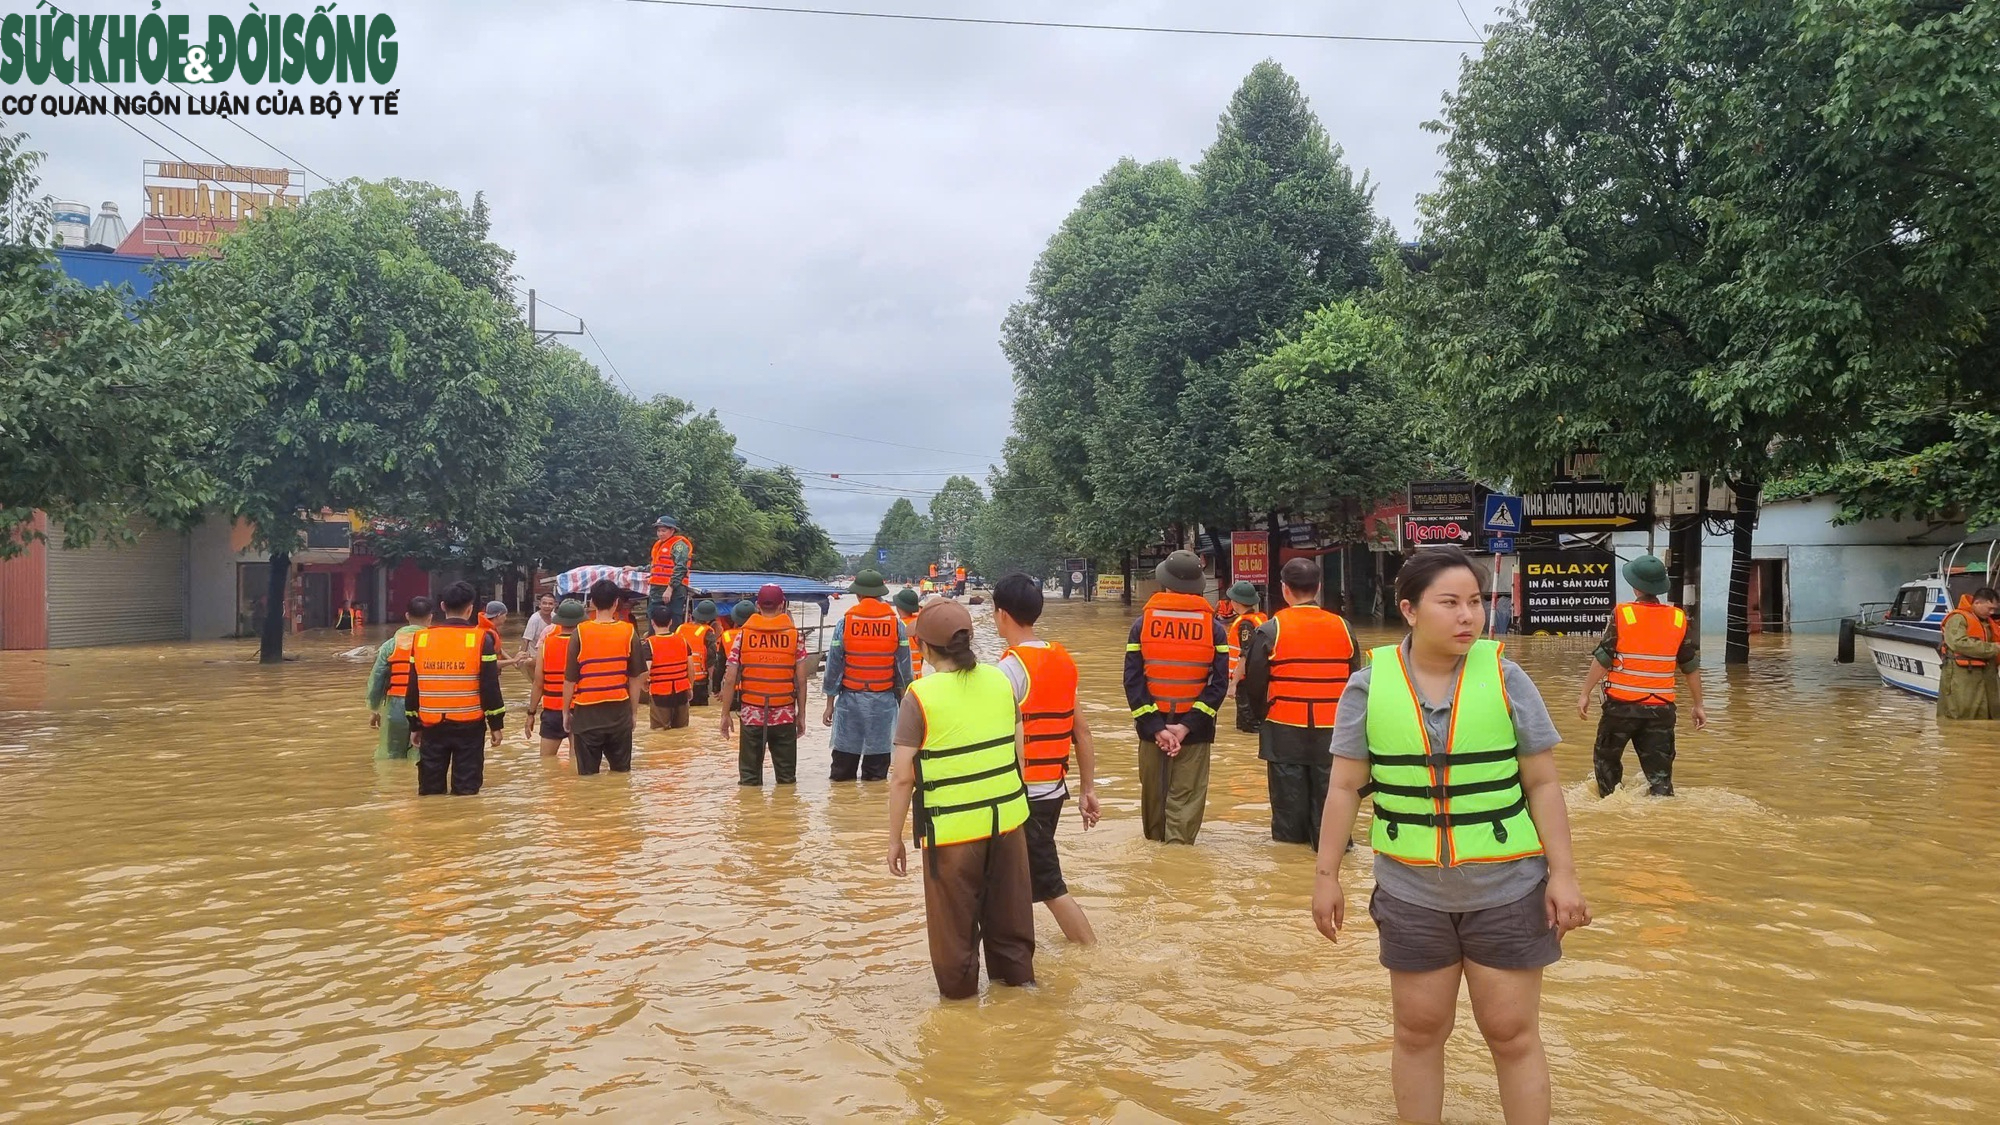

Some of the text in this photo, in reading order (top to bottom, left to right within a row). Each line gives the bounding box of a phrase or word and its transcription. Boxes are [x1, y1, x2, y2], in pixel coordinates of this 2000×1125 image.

[159, 162, 178, 177] AN
[179, 163, 213, 180] NINH
[215, 164, 252, 183] CÔNG
[144, 183, 231, 226] THUẬN
[1249, 543, 1257, 555] XE
[1527, 563, 1609, 575] GALAXY
[1529, 580, 1539, 588] IN
[1541, 578, 1554, 588] ẤN
[1584, 577, 1609, 587] XUẤT
[1529, 596, 1610, 607] BAO BÌ HỘP CỨNG
[1530, 615, 1539, 623] IN
[1541, 615, 1572, 623] NHANH
[1573, 614, 1593, 623] SIÊU
[851, 622, 891, 637] CAND
[1150, 619, 1204, 641] CAND
[749, 634, 789, 648] CAND
